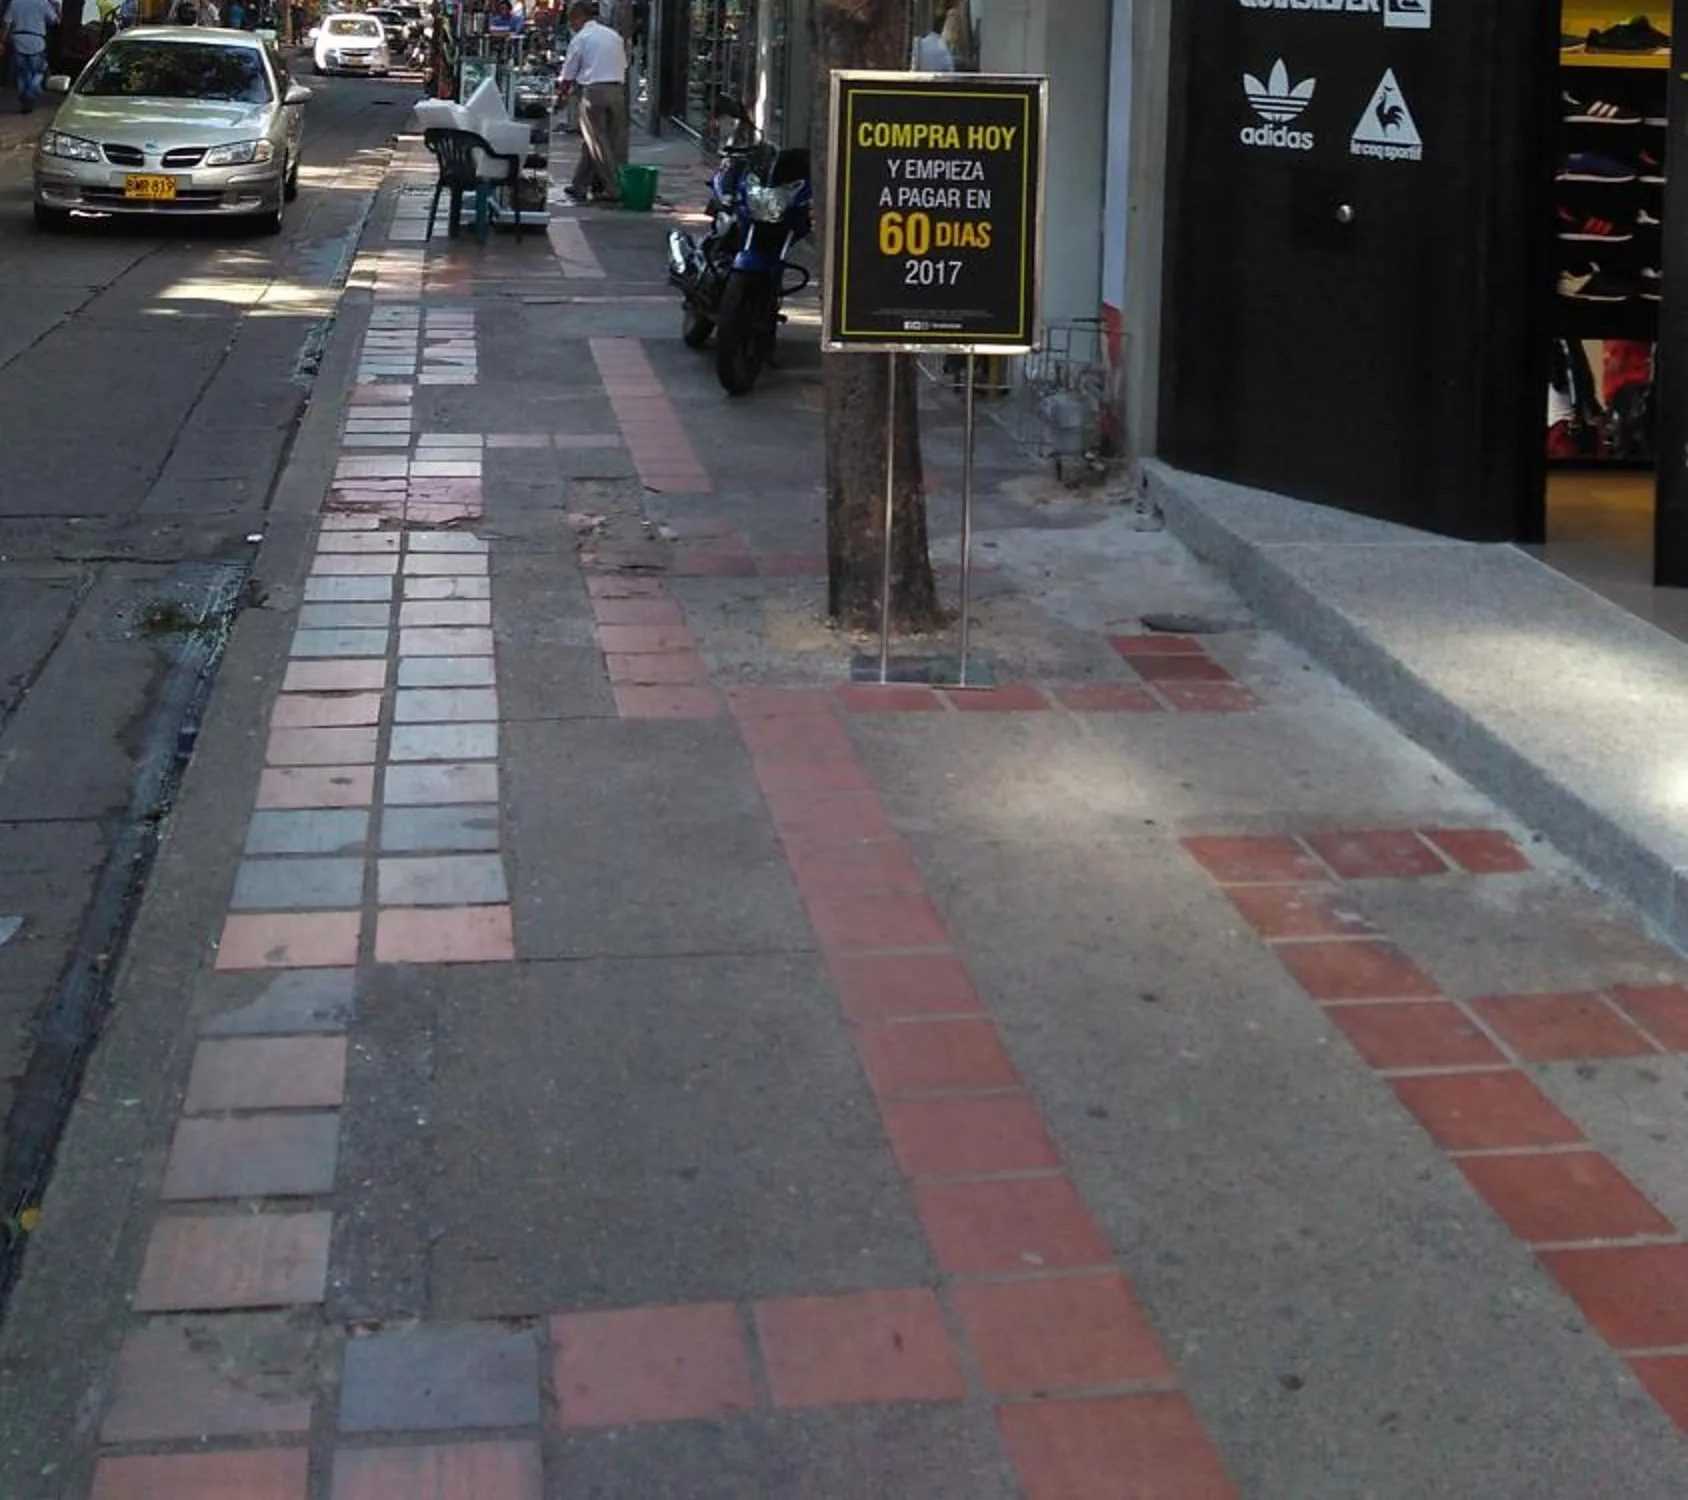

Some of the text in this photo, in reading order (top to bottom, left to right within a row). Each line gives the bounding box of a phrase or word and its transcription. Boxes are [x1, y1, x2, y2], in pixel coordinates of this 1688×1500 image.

[858, 121, 1017, 151] COMPRA HOY
[1240, 124, 1315, 152] adidas
[887, 158, 985, 182] Y EMPIEZA
[879, 186, 991, 209] A PAGAR EN
[879, 211, 993, 256] 60 DIAS
[904, 259, 963, 286] 2017
